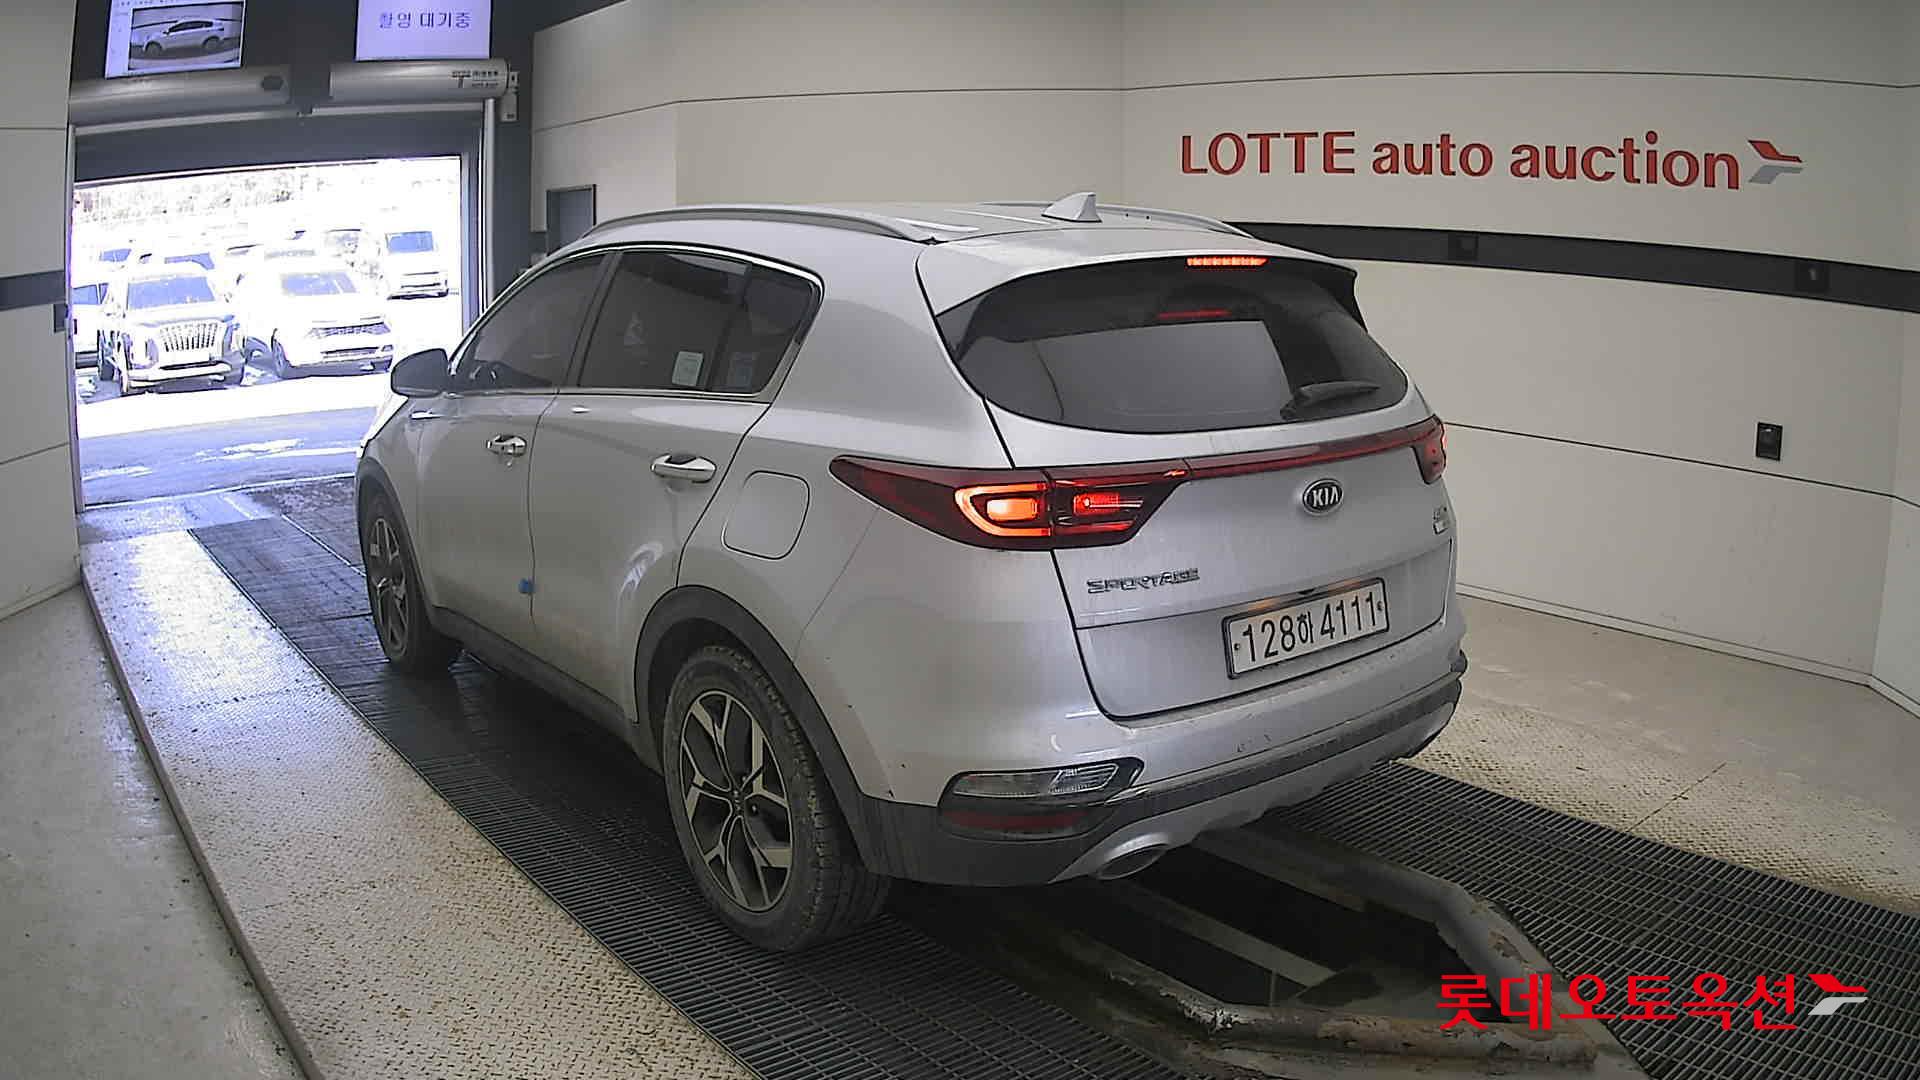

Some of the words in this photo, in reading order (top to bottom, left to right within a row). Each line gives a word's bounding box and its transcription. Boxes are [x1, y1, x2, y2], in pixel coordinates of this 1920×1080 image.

[420, 11, 472, 29] 대기중
[1181, 131, 1355, 175] LOTTE
[1372, 134, 1494, 177] auto
[1510, 131, 1740, 190] auction
[1311, 486, 1339, 507] KIA
[1320, 591, 1377, 640] 4111
